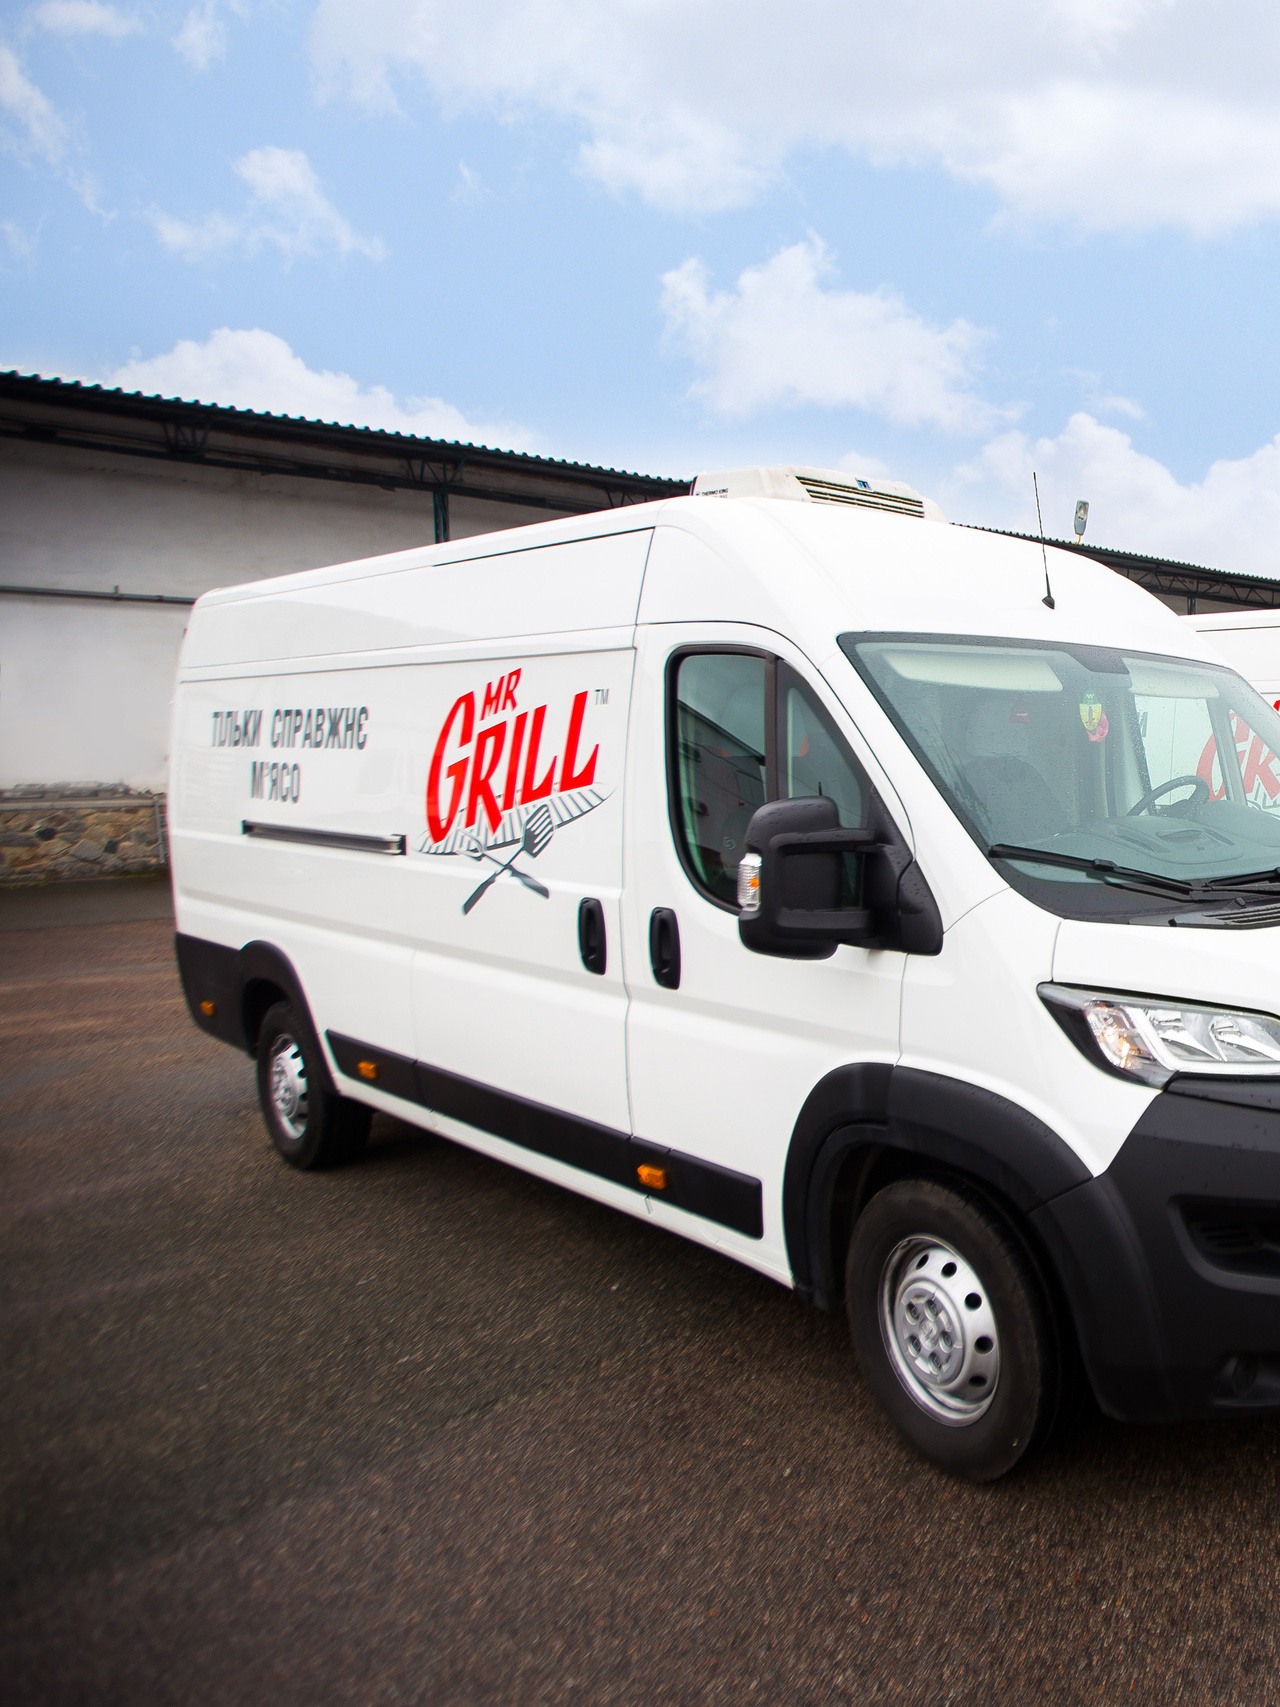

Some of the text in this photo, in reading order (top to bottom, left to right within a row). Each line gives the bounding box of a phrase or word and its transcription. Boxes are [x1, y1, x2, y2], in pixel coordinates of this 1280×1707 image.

[480, 667, 522, 722] MR
[595, 688, 610, 706] TM
[211, 706, 369, 750] ТІЛЬКИ СПРАВЖНЄ
[426, 690, 600, 844] GRILL
